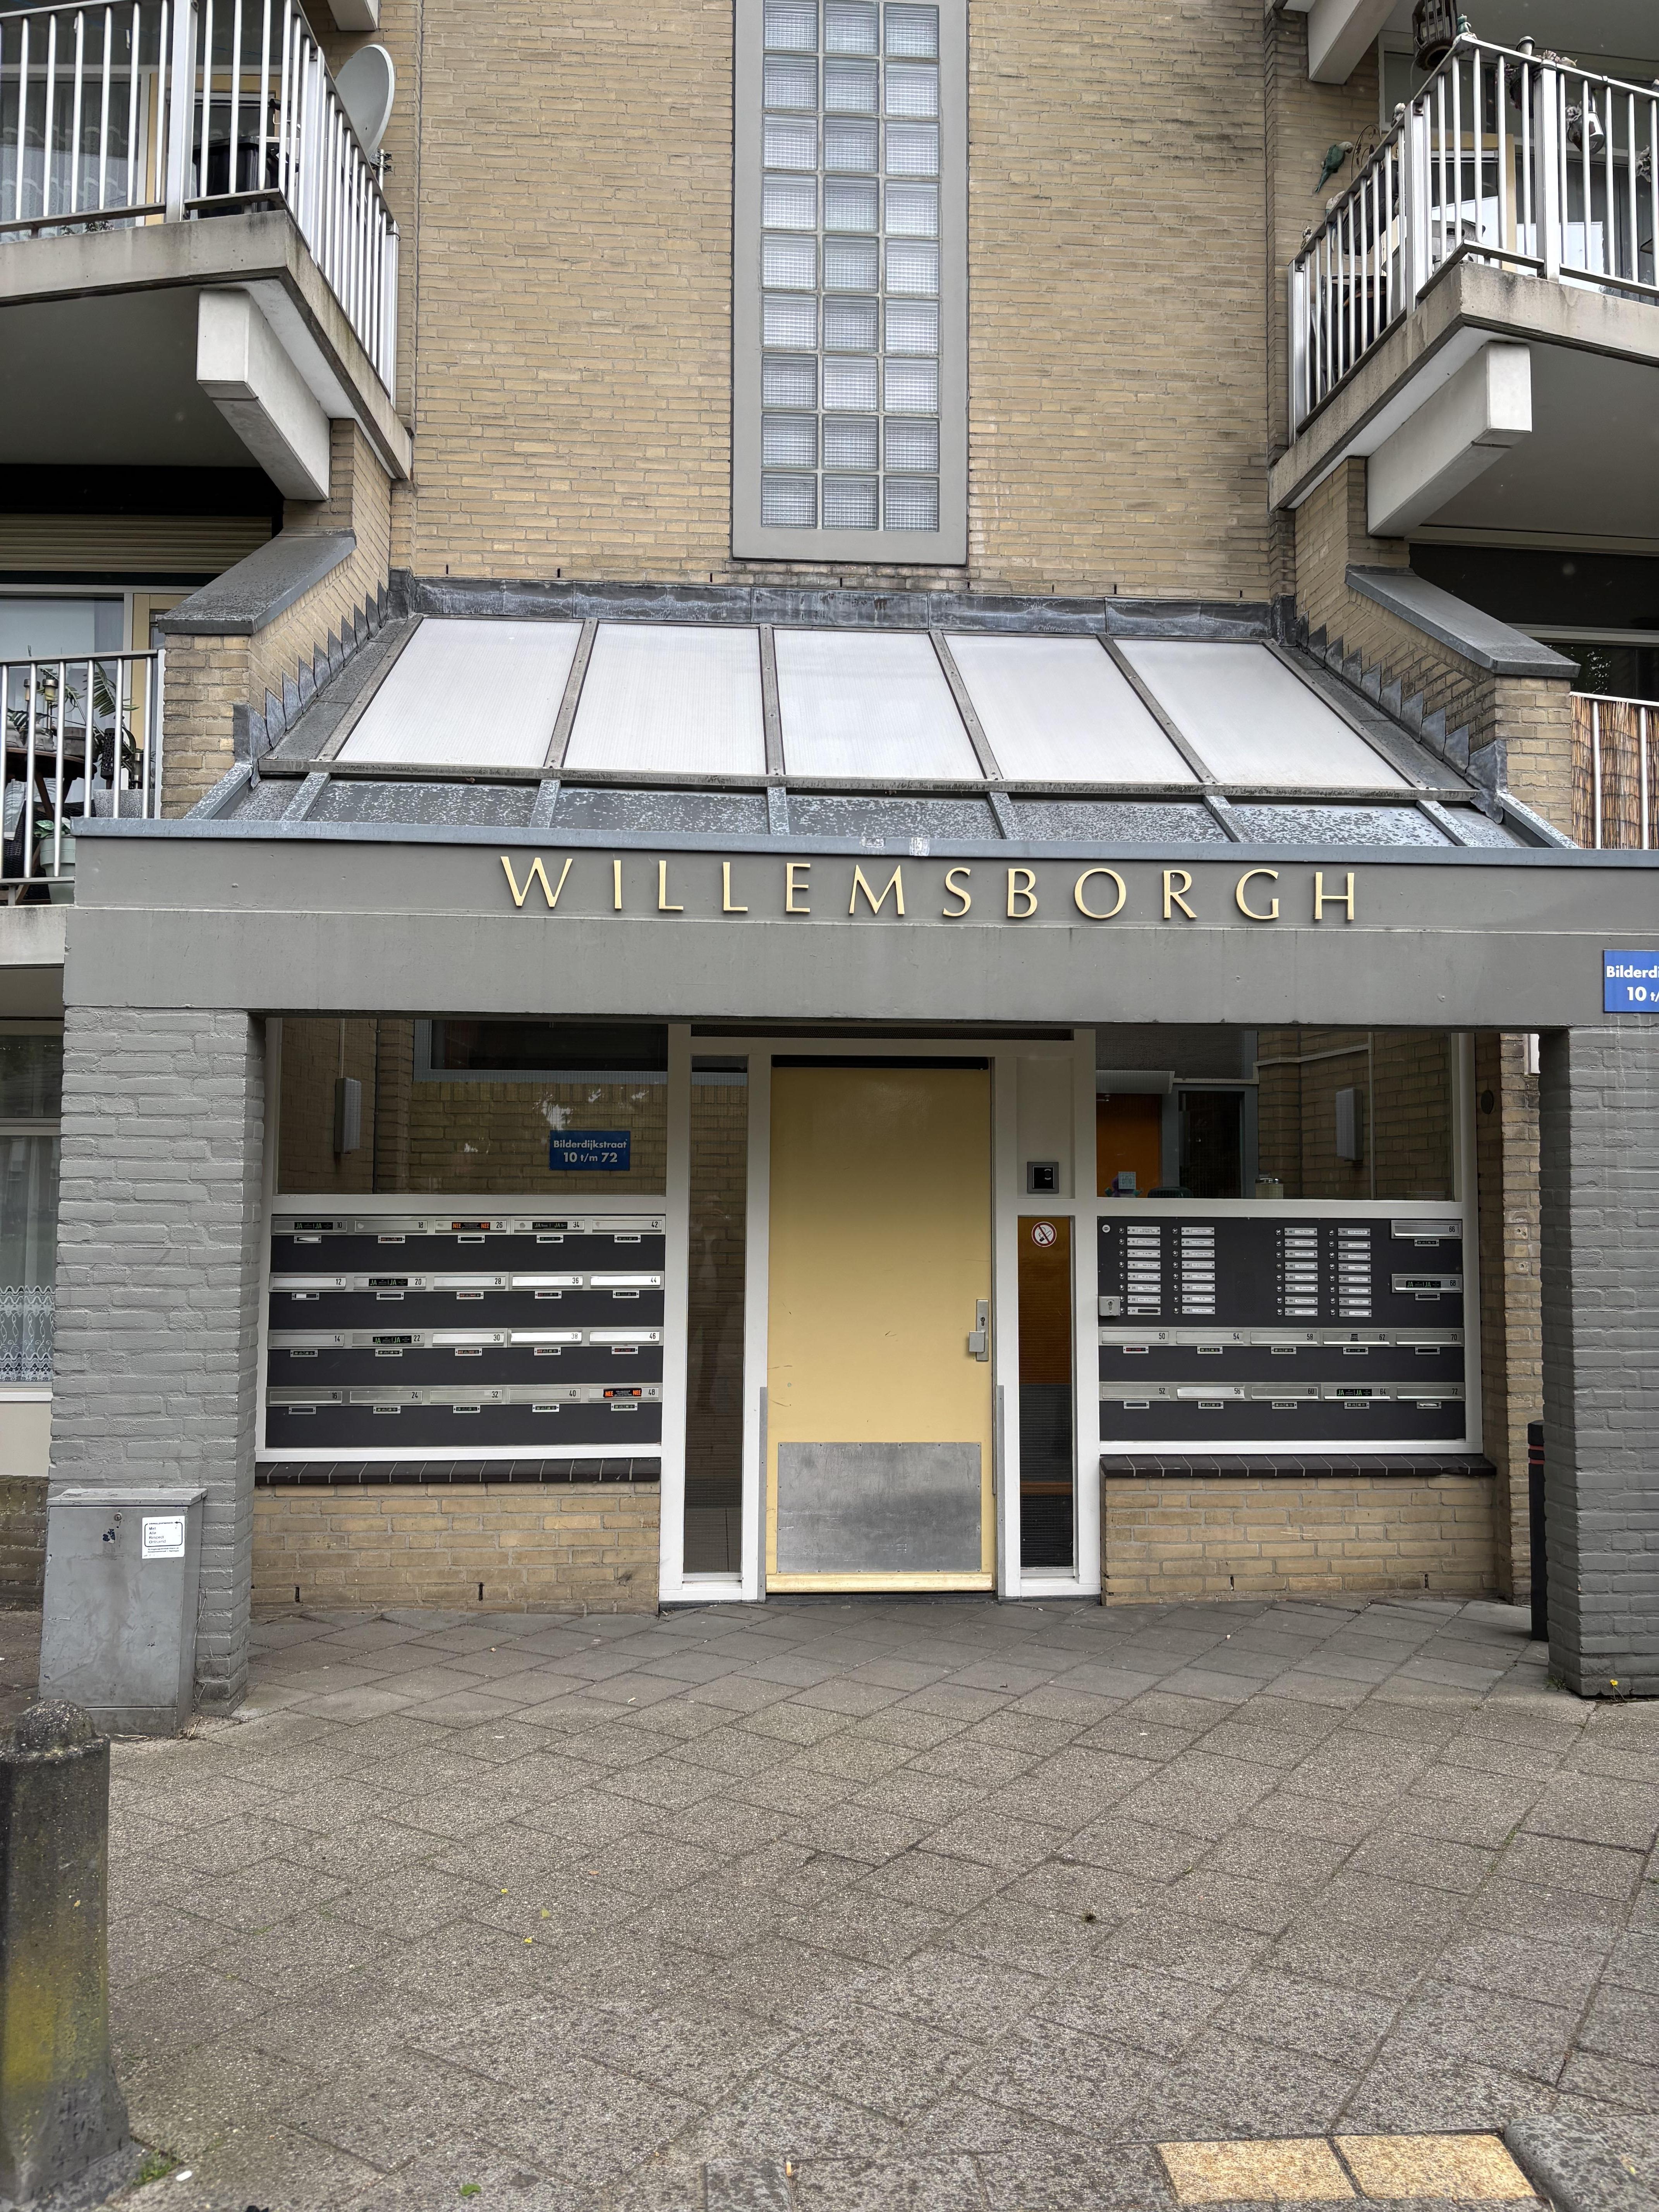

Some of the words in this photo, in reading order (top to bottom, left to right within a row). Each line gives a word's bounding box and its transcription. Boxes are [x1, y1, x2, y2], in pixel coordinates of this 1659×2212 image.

[500, 856, 1355, 921] WILLEMSBORGH
[1627, 986, 1647, 1001] 10
[553, 1140, 627, 1150] Bilderdijkstraat
[563, 1152, 577, 1163] 10
[580, 1153, 598, 1162] t/m
[601, 1152, 617, 1163] 72
